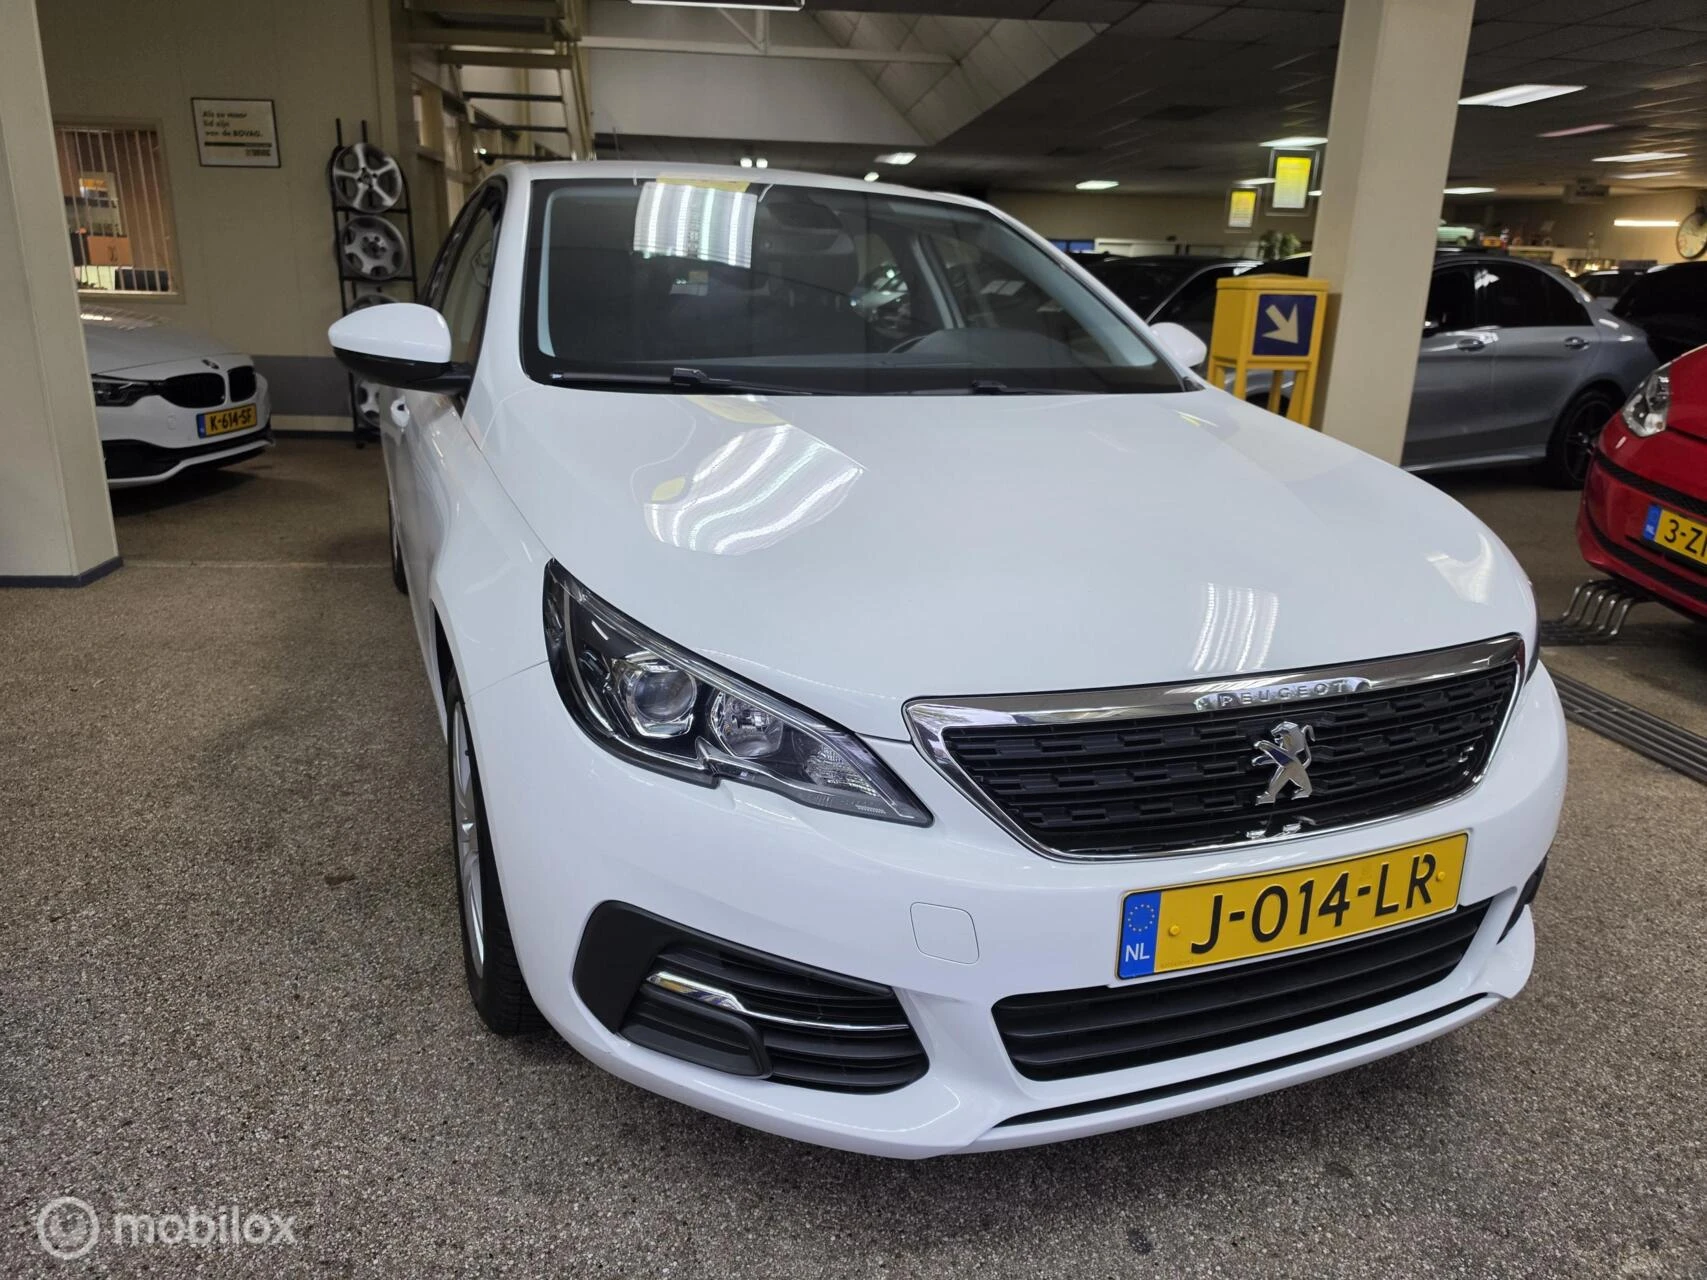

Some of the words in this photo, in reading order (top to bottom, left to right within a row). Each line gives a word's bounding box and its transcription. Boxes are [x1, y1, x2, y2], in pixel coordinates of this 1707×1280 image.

[210, 407, 252, 431] K-614-SF
[1664, 519, 1707, 557] 3-Z
[1219, 679, 1348, 707] PEUGEOT
[1190, 853, 1437, 955] J-014-LR
[1124, 943, 1151, 962] NL
